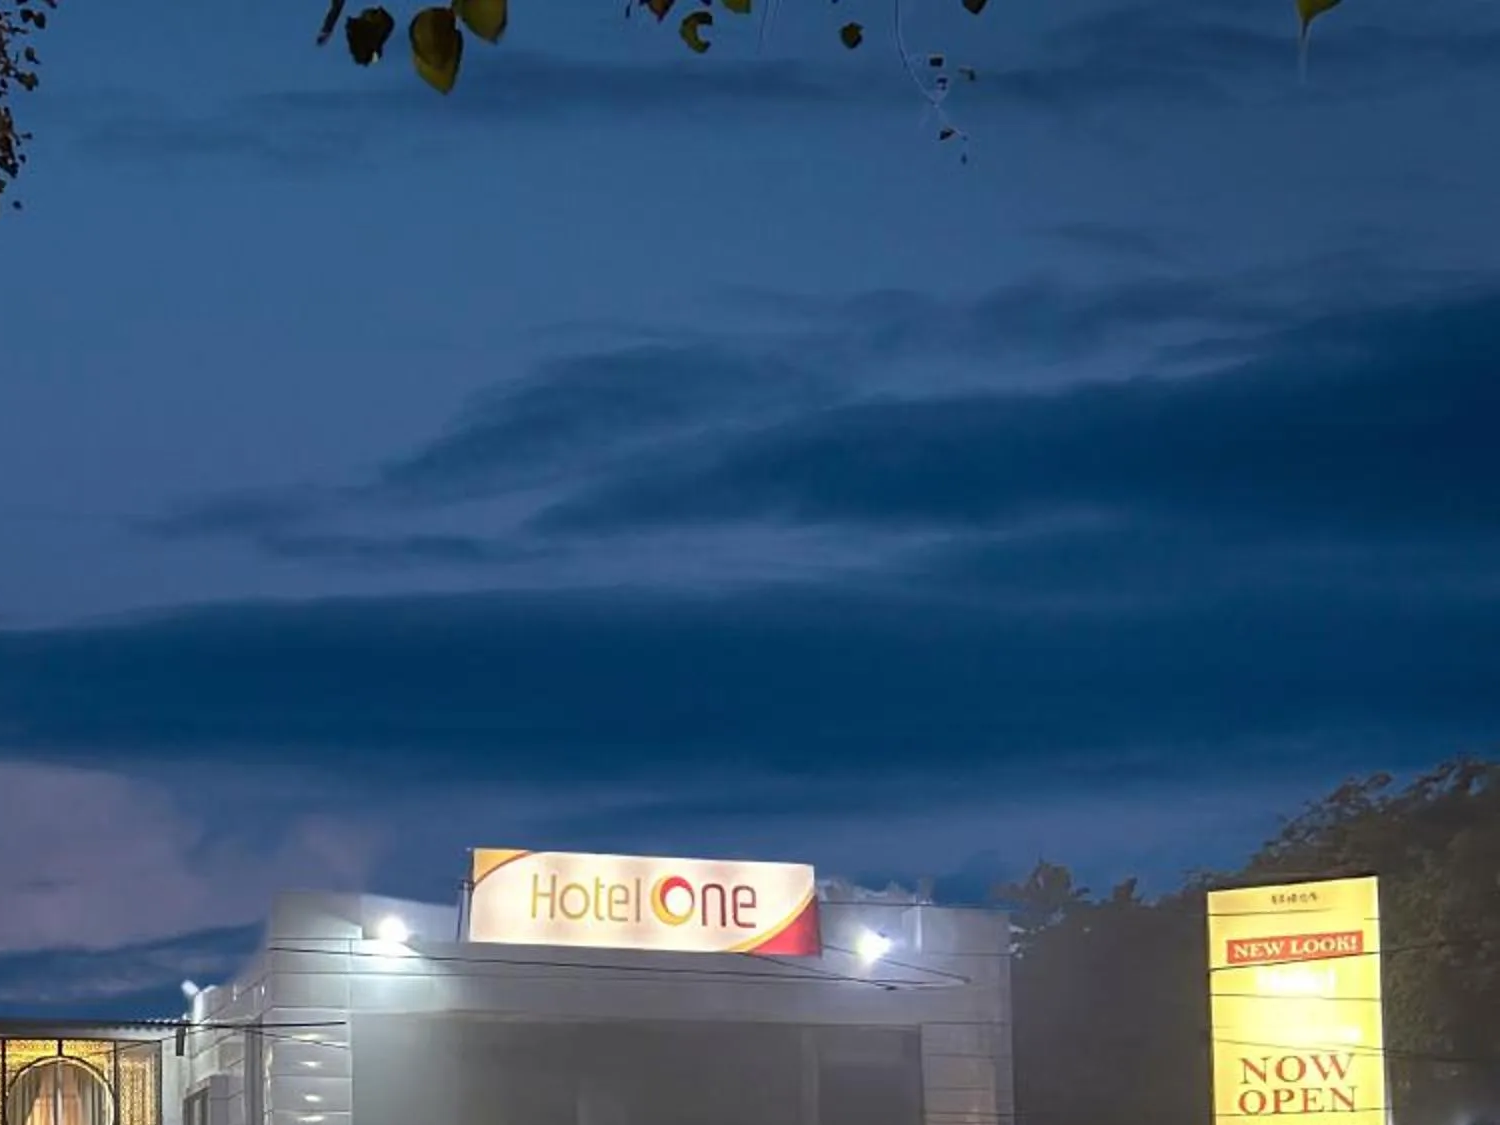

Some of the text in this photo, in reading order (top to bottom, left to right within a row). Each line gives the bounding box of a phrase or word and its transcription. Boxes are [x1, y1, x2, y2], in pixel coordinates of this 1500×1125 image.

[531, 873, 757, 929] Hotel One
[1233, 936, 1359, 960] NEW LOOK!
[1240, 1053, 1356, 1085] NOW
[1238, 1086, 1358, 1115] OPEN
